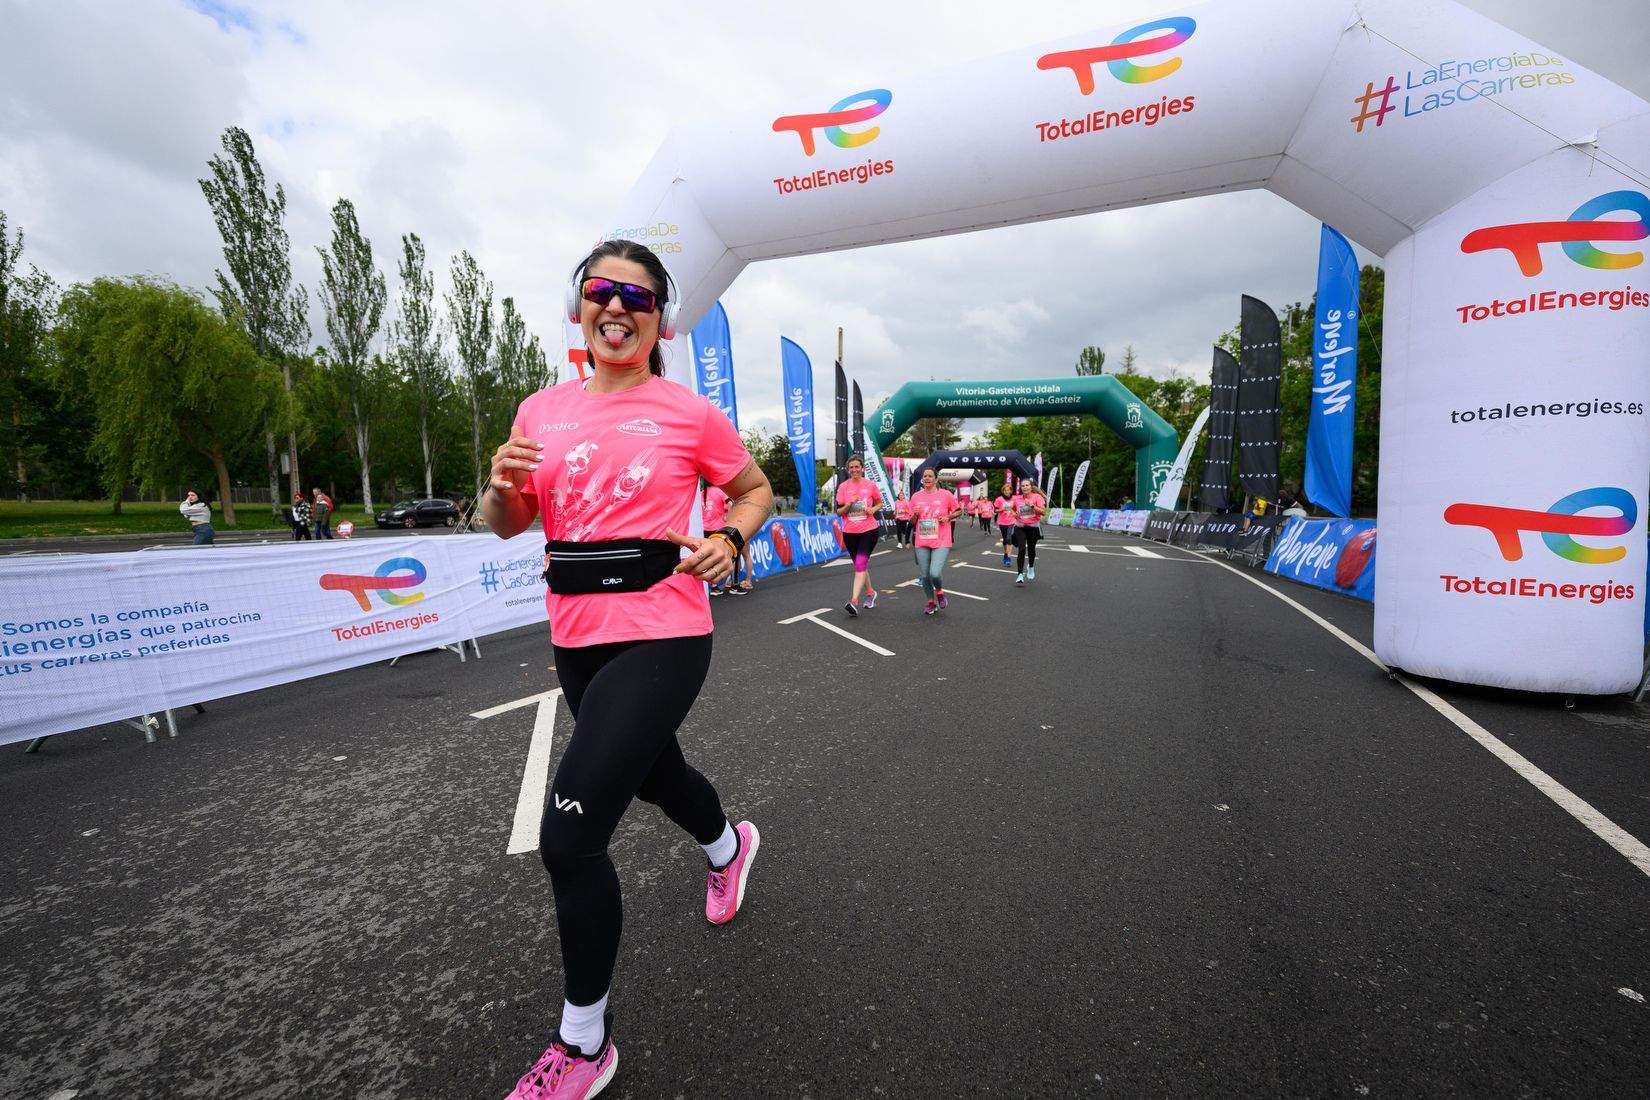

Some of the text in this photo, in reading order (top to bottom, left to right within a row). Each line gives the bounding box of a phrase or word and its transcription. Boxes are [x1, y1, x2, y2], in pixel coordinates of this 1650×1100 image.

[1404, 72, 1575, 118] LasCarreras
[1035, 95, 1195, 142] TotalEnergies
[773, 159, 894, 195] TotalEnergies
[1456, 285, 1650, 324] TotalEnergies
[936, 395, 1081, 408] Ayuntamiento de Vitoria-Gasteiz
[955, 385, 1061, 396] Vitoria-Gasteizko Udala
[1451, 398, 1643, 424] totalenergies.es
[1151, 520, 1171, 530] VOLVO
[1207, 523, 1237, 533] VOLVO
[1440, 575, 1635, 604] TotalEnergies
[0, 611, 262, 658] ienergías que patrocina
[2, 601, 209, 636] Somos la compañía
[332, 611, 440, 642] TotalEnergies
[41, 648, 132, 670] carreras
[137, 631, 230, 658] preferidas
